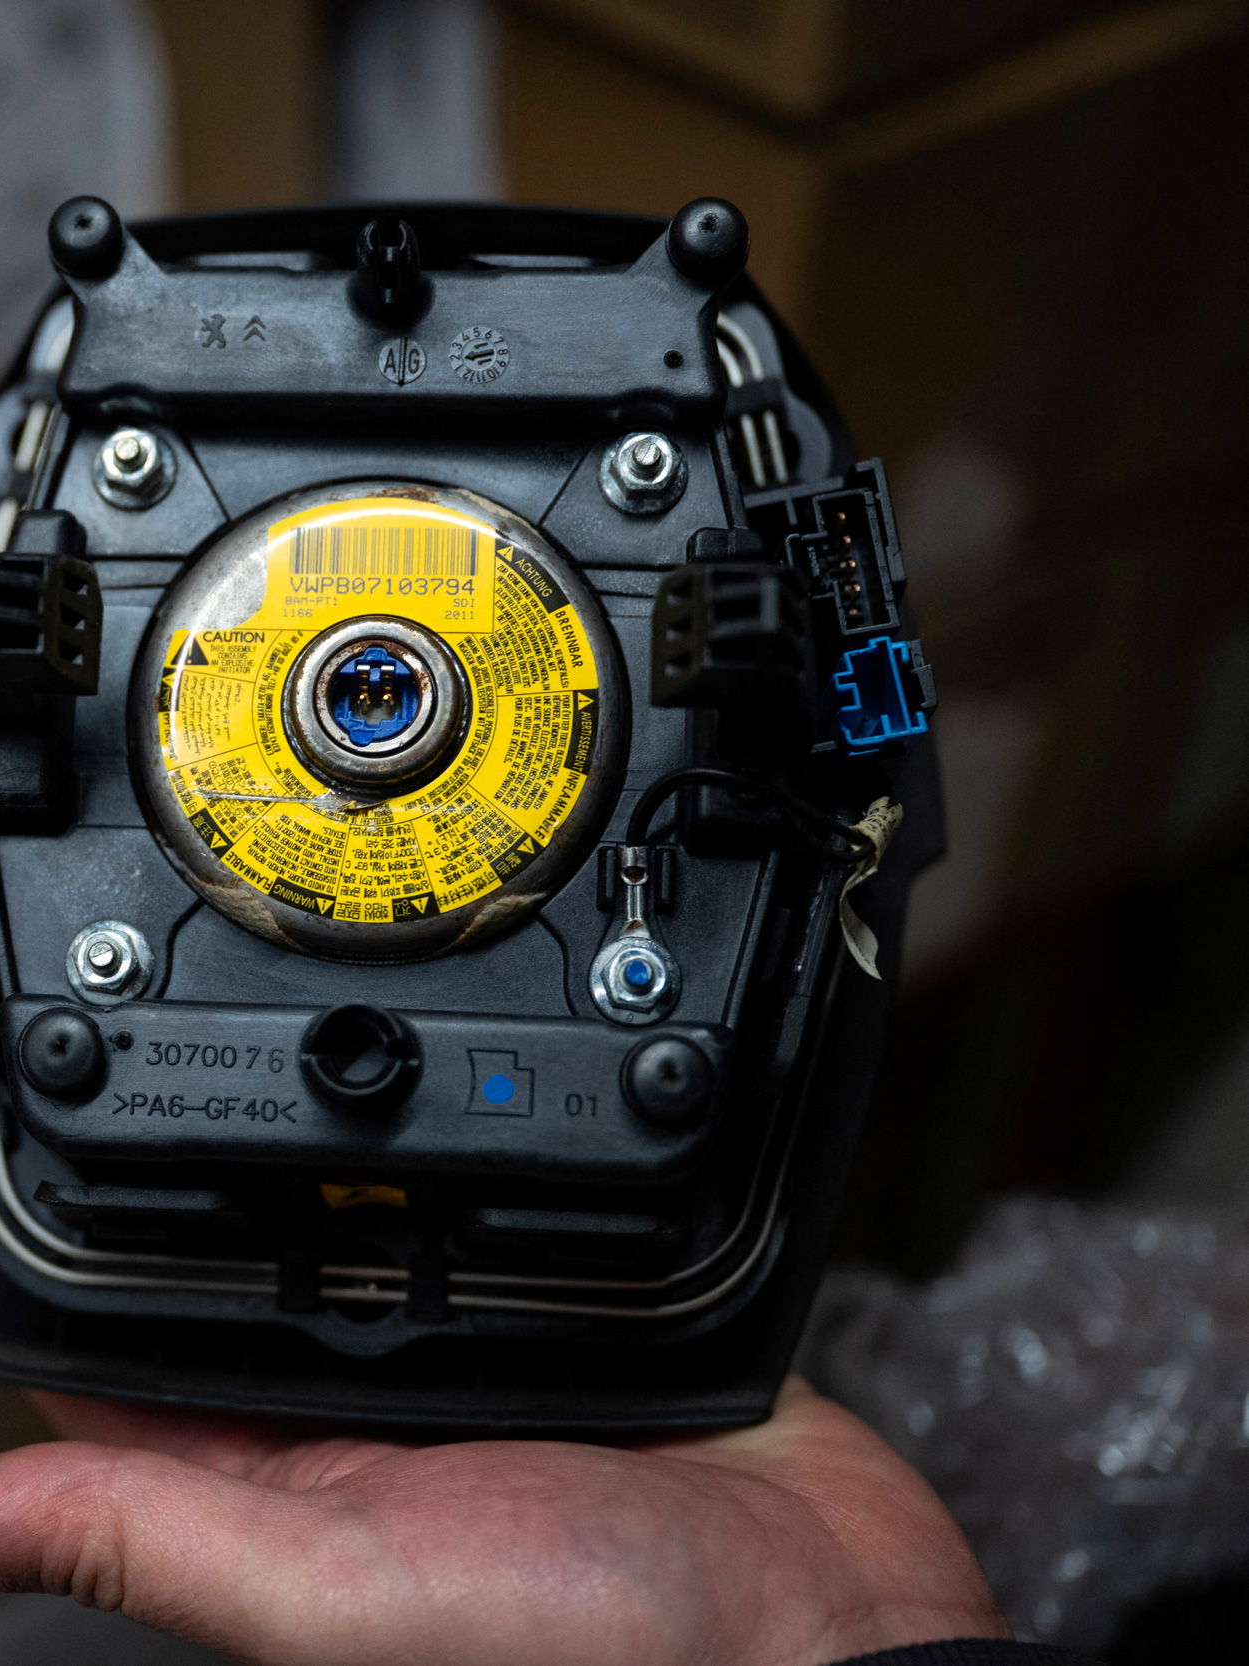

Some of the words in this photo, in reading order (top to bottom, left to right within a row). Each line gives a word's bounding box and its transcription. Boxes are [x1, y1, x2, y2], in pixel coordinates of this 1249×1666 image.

[383, 348, 396, 373] A
[408, 348, 420, 374] G
[514, 558, 552, 597] ACHTUNG
[289, 576, 475, 595] VWPB07103794
[497, 564, 508, 575] ZUR
[529, 599, 539, 609] VON
[285, 596, 337, 605] BAM-PT1
[453, 598, 474, 607] SDI
[493, 600, 506, 611] EIN
[283, 608, 312, 617] 1166
[445, 610, 474, 619] 2011
[202, 630, 264, 642] CAUTION
[555, 610, 583, 668] BRENNBAR
[228, 644, 256, 652] ASSEMBLY
[548, 661, 557, 672] MIT
[515, 697, 523, 711] POUR
[534, 696, 542, 704] UN
[543, 696, 551, 705] UNE
[561, 694, 570, 709] POUR
[514, 713, 523, 727] PLUS
[533, 706, 542, 721] AUTRE
[523, 716, 532, 730] VOIR
[521, 731, 530, 739] LE
[558, 732, 568, 749] TOUTE
[576, 711, 591, 772] AVERTISSEMENT
[511, 761, 521, 770] DE
[545, 779, 554, 787] NE
[501, 797, 510, 806] DE
[510, 795, 524, 810] DANS
[535, 772, 579, 840] INFLAMMABLE
[192, 814, 214, 838] 注意
[311, 833, 332, 846] REPAIR
[333, 840, 345, 849] SEE
[302, 848, 316, 859] INTO
[325, 847, 343, 858] STORE
[299, 858, 323, 872] CONTACT
[495, 852, 522, 874] 警告
[225, 851, 273, 891] FLAMMABLE
[324, 865, 338, 876] INTO
[308, 880, 326, 891] AVOID
[326, 885, 334, 894] TO
[437, 871, 498, 908] 可燃性材料
[273, 884, 318, 909] WARNING
[364, 903, 389, 921] 화염성
[393, 899, 411, 917] 경고
[565, 1093, 598, 1116] 01
